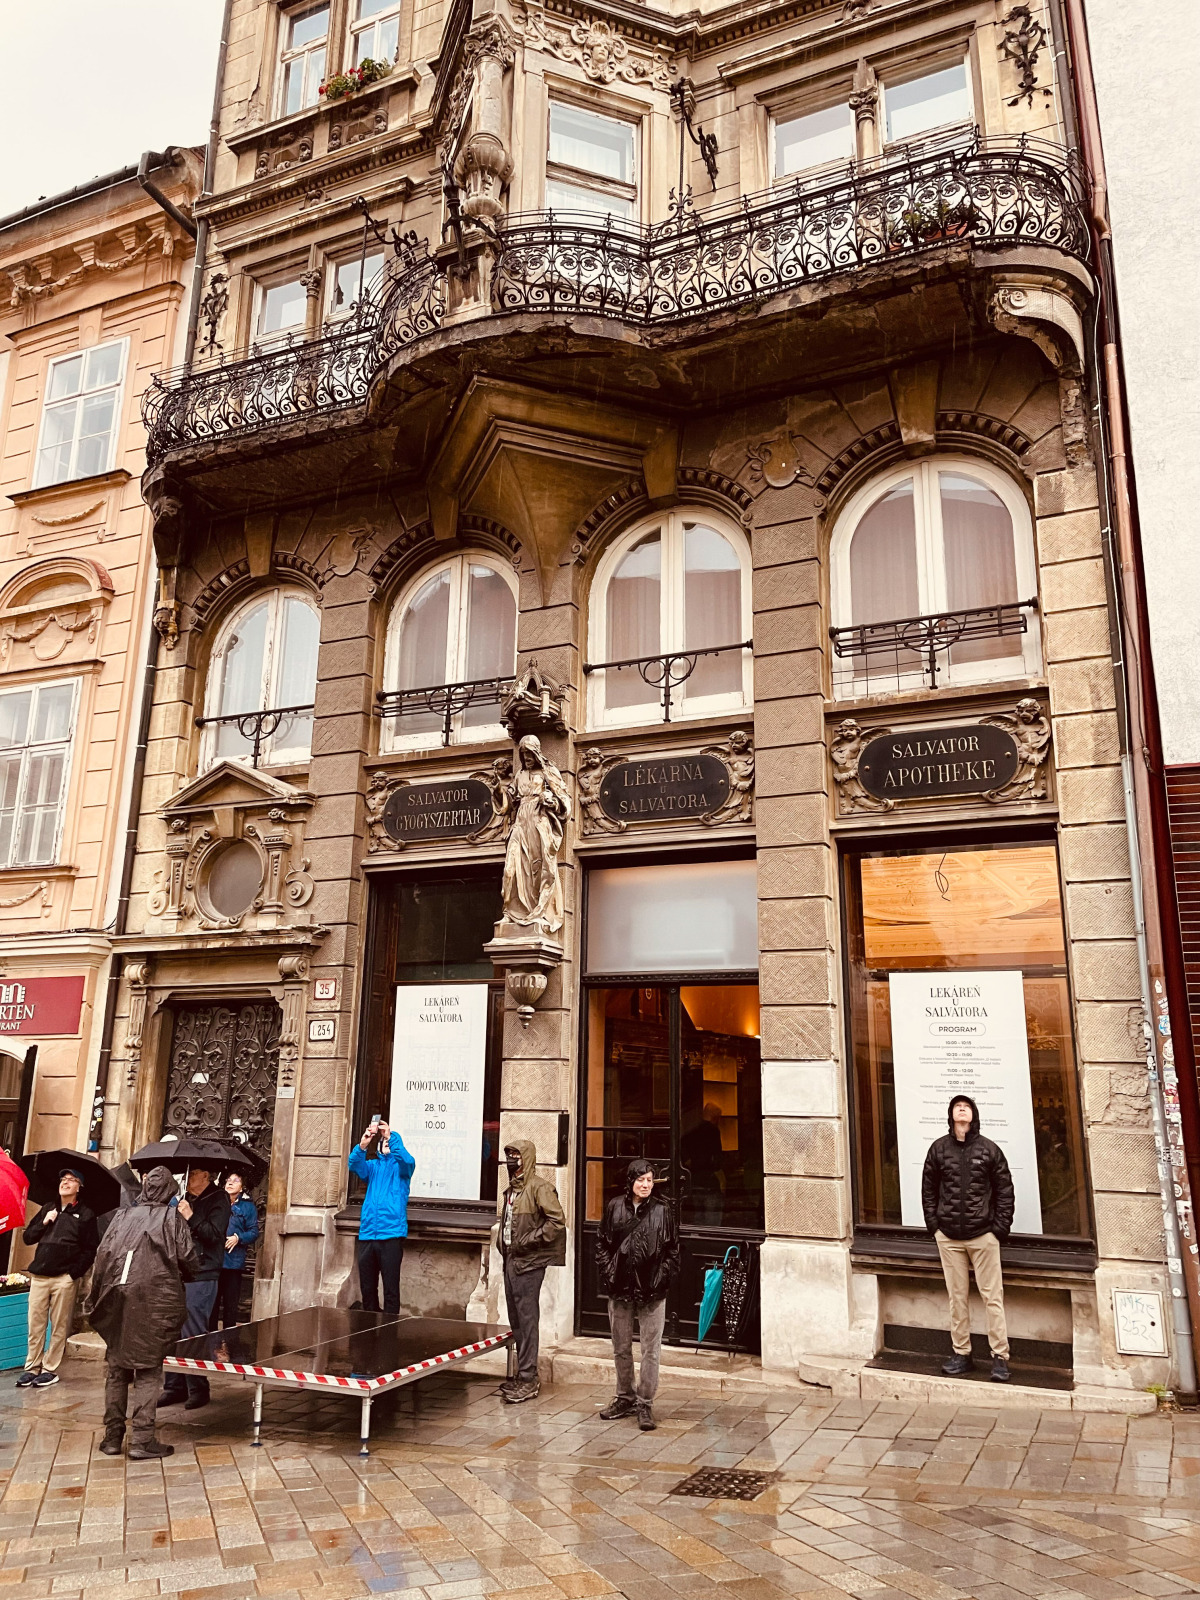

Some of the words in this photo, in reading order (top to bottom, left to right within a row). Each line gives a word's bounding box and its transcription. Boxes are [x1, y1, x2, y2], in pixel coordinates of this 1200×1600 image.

[892, 735, 980, 760] SALVATOR
[884, 759, 996, 788] APOTHEKE
[660, 785, 667, 794] U
[407, 788, 468, 807] SALVATOR
[618, 793, 711, 814] SALVATORA.
[319, 983, 330, 995] 35
[930, 984, 981, 998] LEKÁREŇ
[952, 998, 959, 1006] U
[418, 1013, 463, 1023] SALVATORA
[925, 1006, 988, 1018] SALVATORA
[317, 1024, 331, 1036] 254
[406, 1079, 470, 1092] (PO)OTVORENIE
